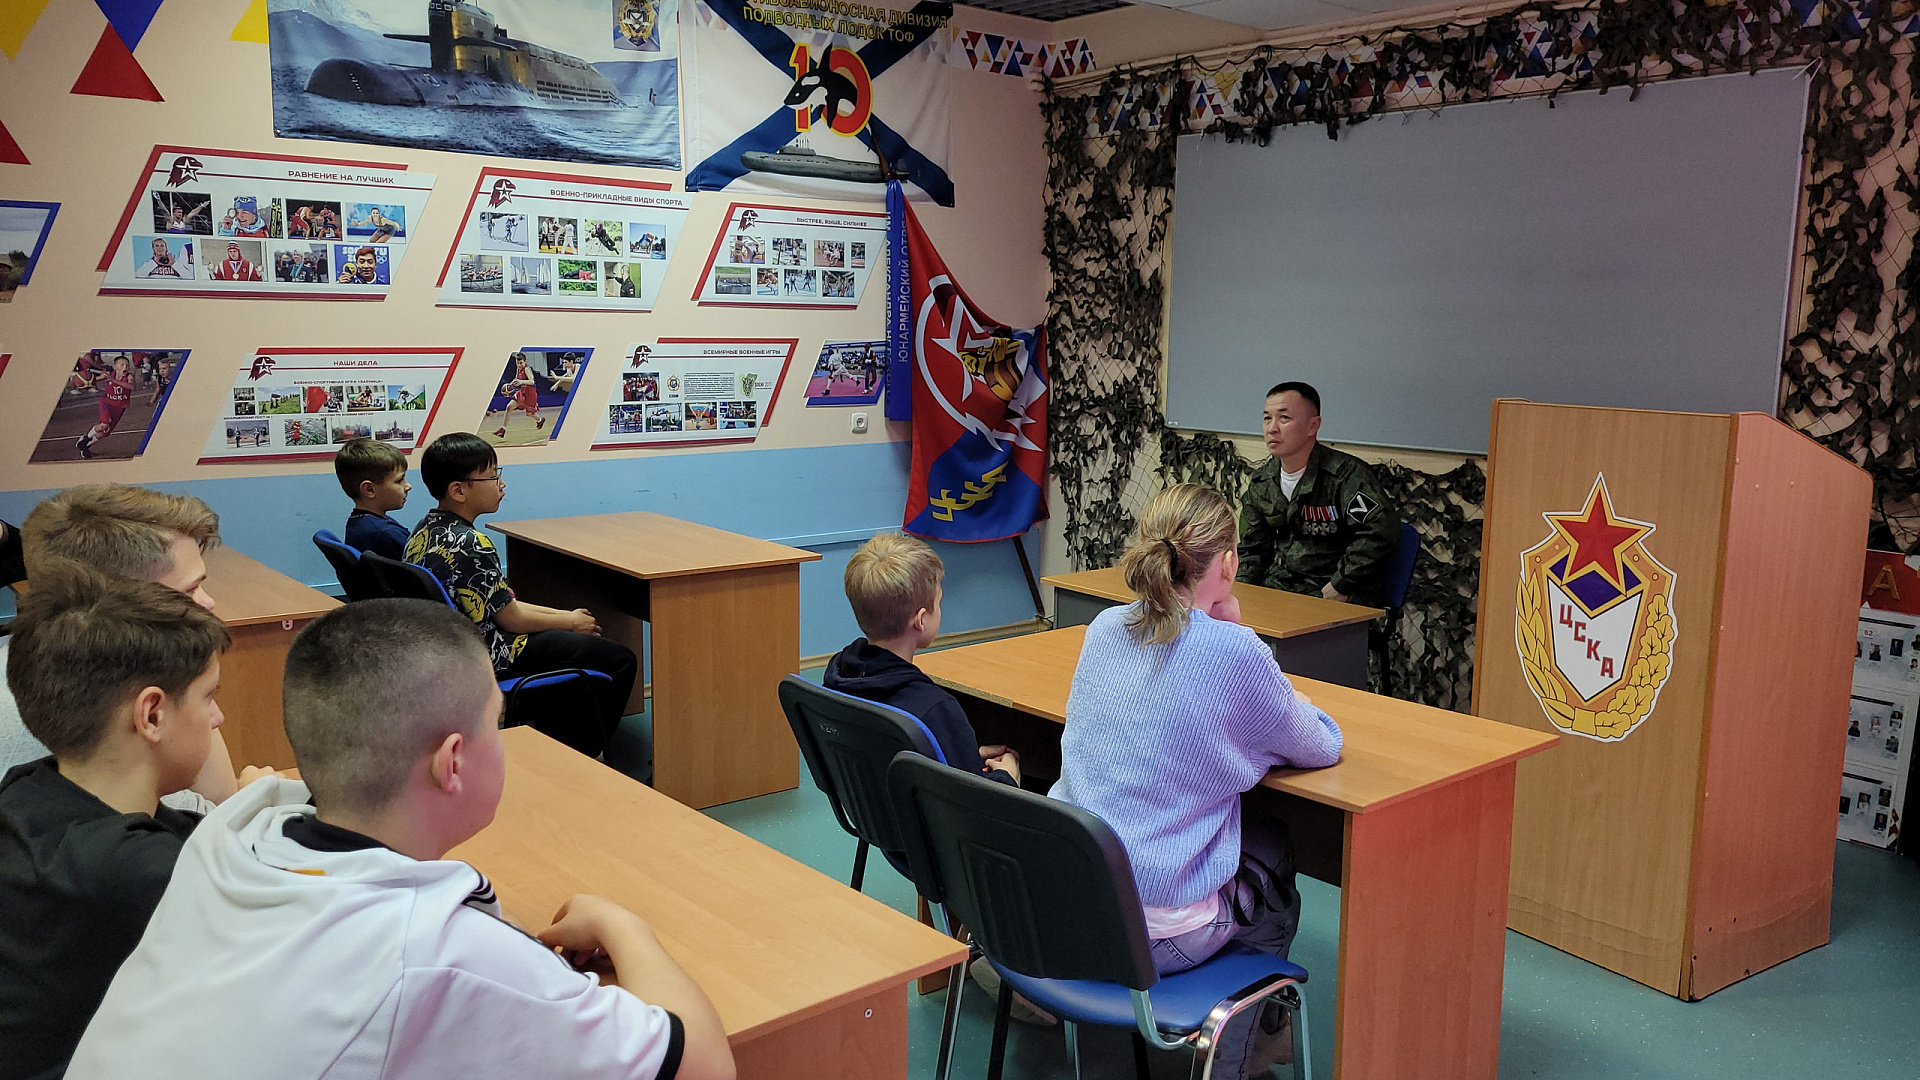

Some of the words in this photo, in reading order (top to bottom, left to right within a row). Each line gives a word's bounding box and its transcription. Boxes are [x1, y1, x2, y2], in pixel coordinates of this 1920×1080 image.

[743, 6, 835, 32] ПОДВОДНЫХ
[838, 20, 884, 40] ЛОДОК
[887, 28, 915, 42] ТОФ
[888, 9, 948, 28] ДИВИЗИЯ
[789, 42, 873, 137] 10
[288, 170, 338, 180] РАВНЕНИЕ
[340, 173, 354, 181] НА
[355, 175, 395, 184] ЛУЧШИХ
[550, 189, 633, 202] ВОЕННО-ПРИКЛАДНЫЕ
[634, 196, 655, 204] ВИДЫ
[656, 198, 683, 206] СПОРТА
[897, 258, 911, 362] ЮНАРМЕЙСКИЙ
[1559, 603, 1614, 679] ЦСКА
